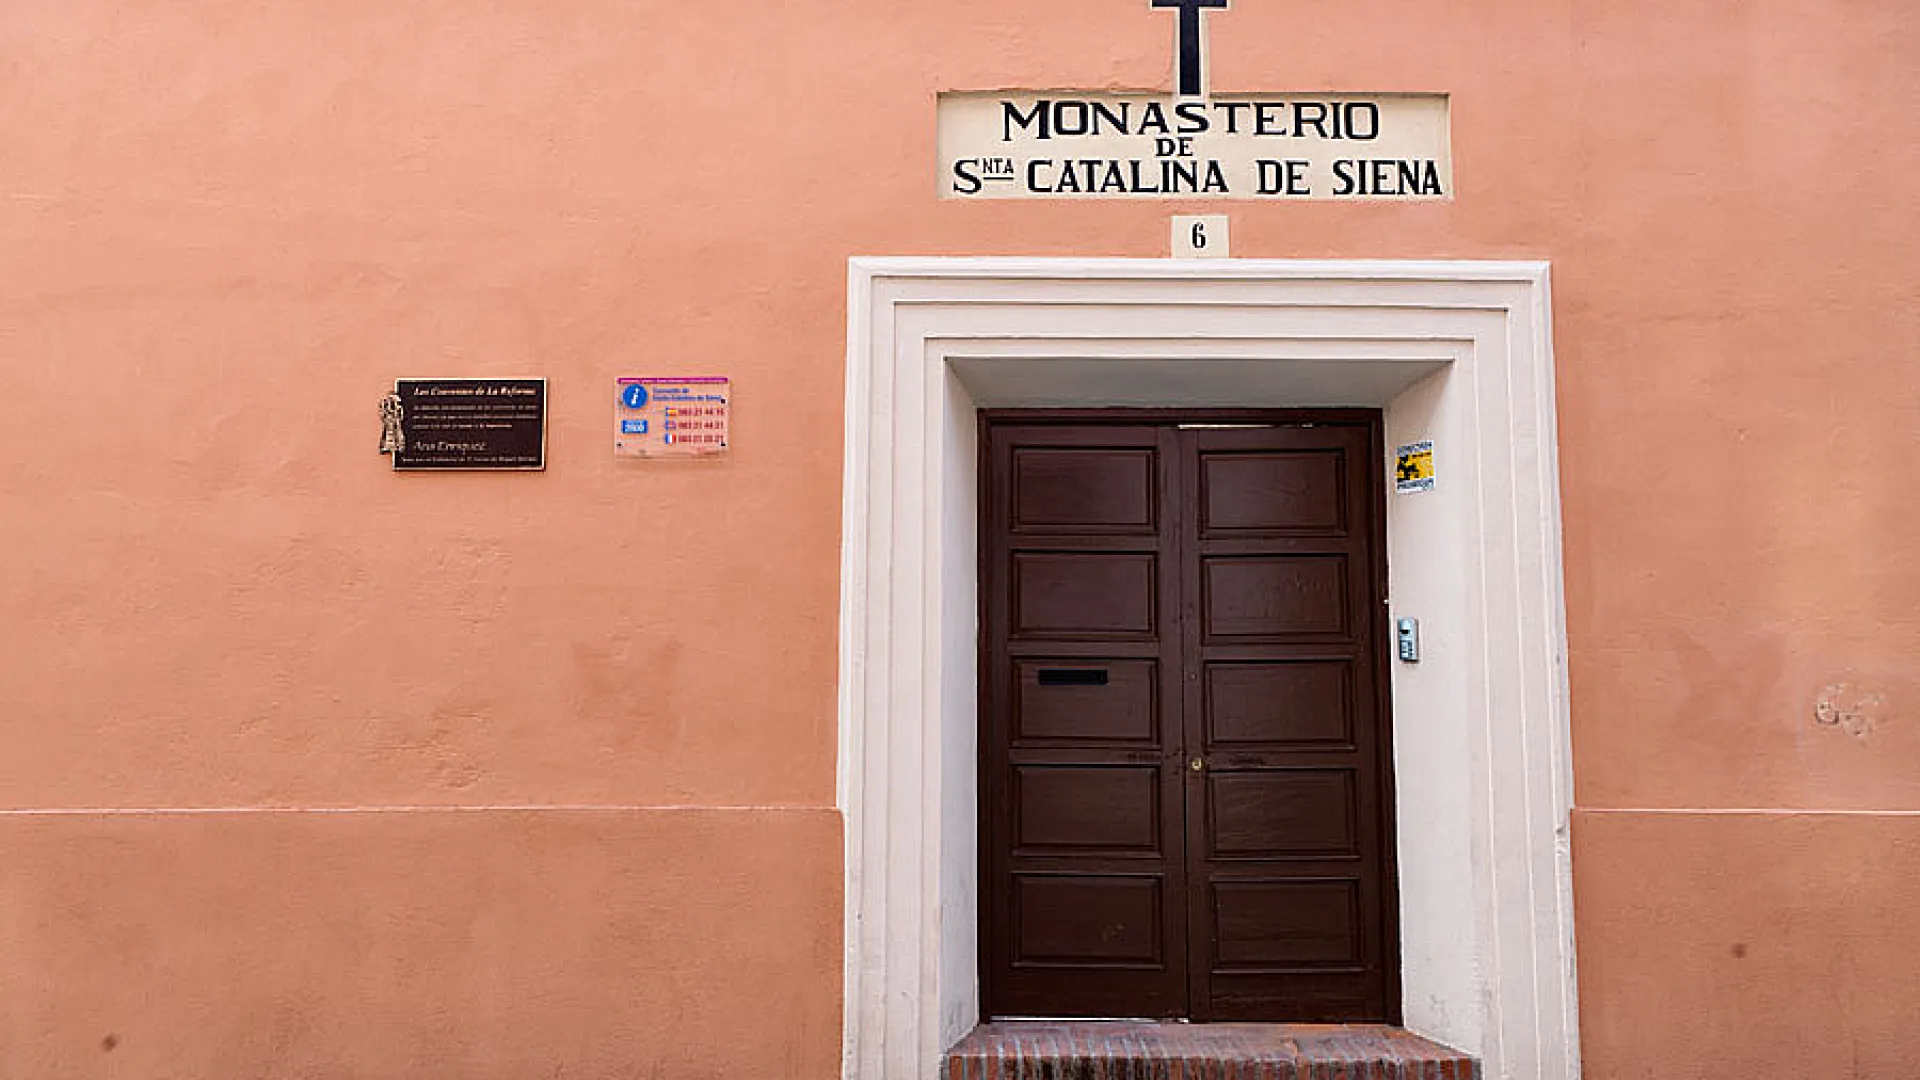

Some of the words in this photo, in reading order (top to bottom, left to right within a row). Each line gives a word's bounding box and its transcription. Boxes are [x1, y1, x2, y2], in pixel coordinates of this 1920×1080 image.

[1001, 101, 1379, 141] MONASTERIO
[1155, 137, 1194, 157] DE
[1027, 160, 1230, 193] CATALINA
[1256, 160, 1311, 195] DE
[1333, 160, 1443, 195] SIENA
[1191, 222, 1206, 249] 6
